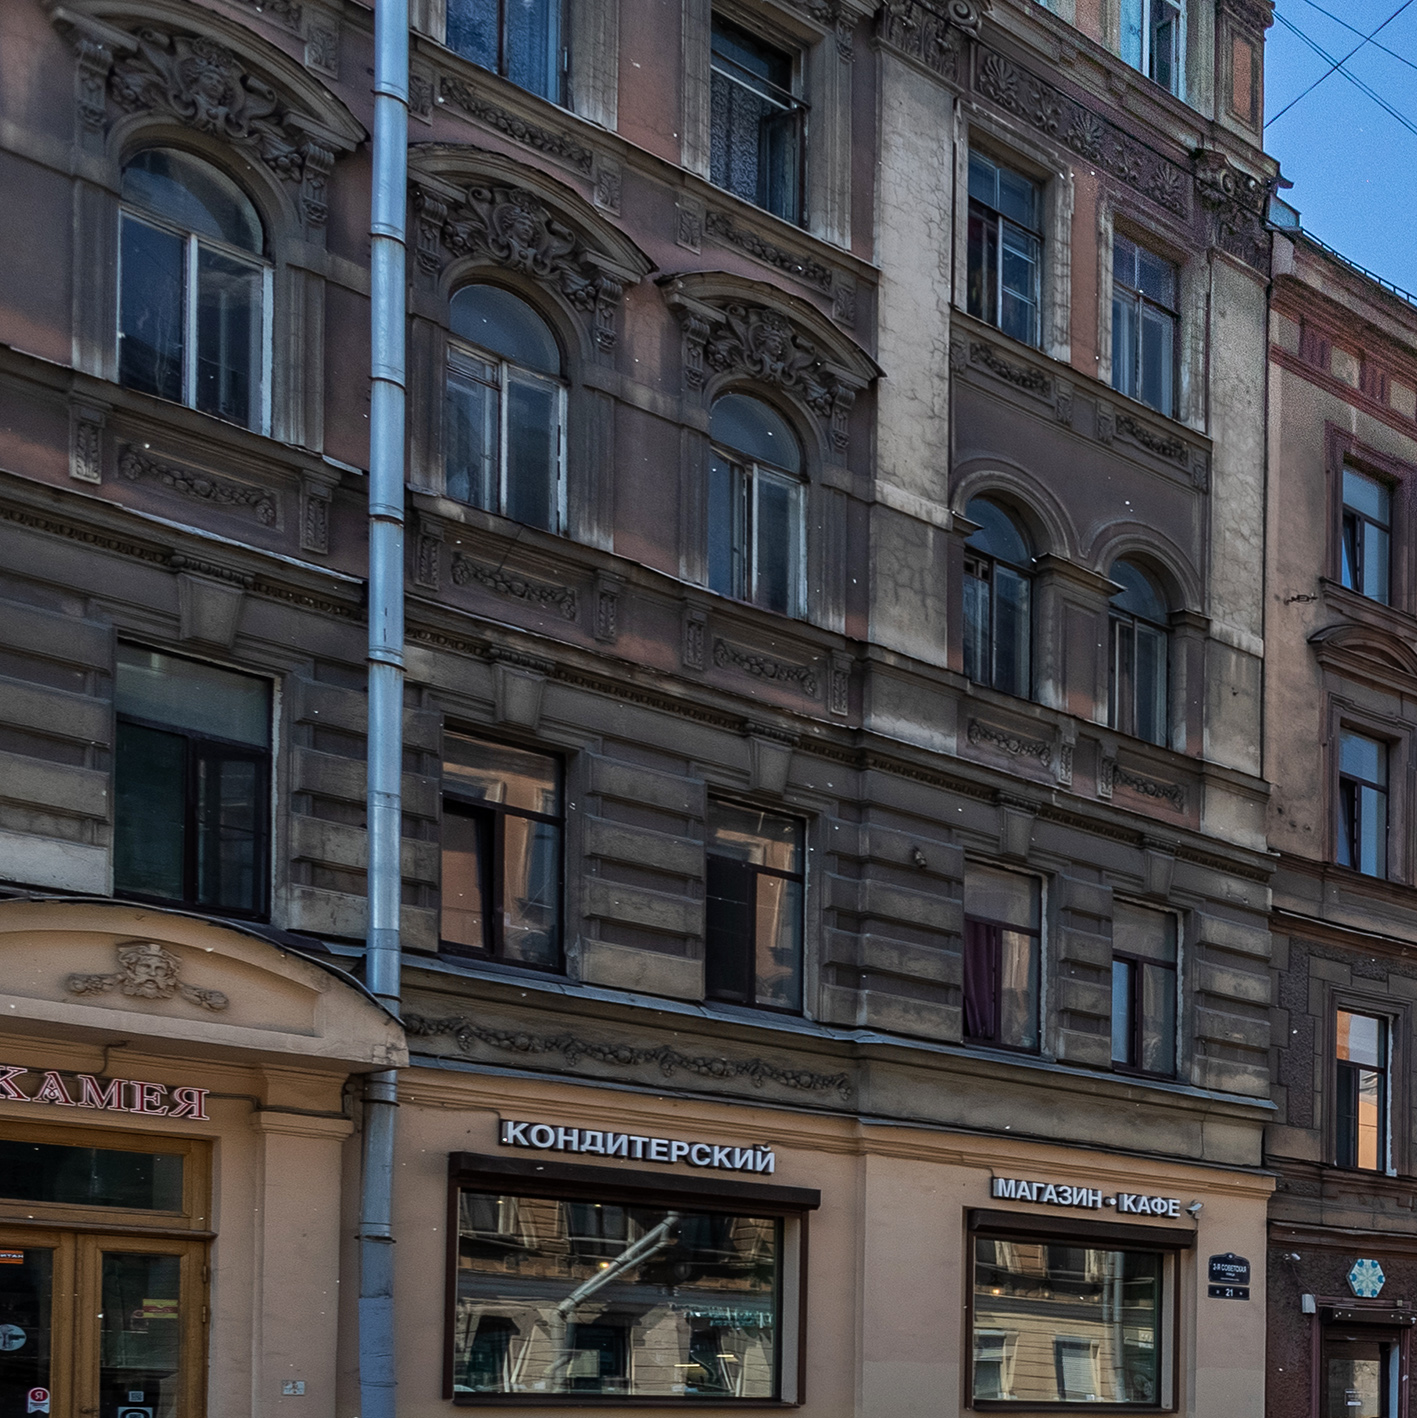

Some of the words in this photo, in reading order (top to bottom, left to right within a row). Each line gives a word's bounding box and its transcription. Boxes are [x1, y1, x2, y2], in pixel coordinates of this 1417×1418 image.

[0, 1066, 210, 1121] КАМЕЯ
[503, 1121, 775, 1174] КОНДИТЕРСКИЙ
[995, 1178, 1103, 1209] МАГАЗИН
[1119, 1193, 1181, 1217] КАФЕ
[1225, 1288, 1234, 1297] 21
